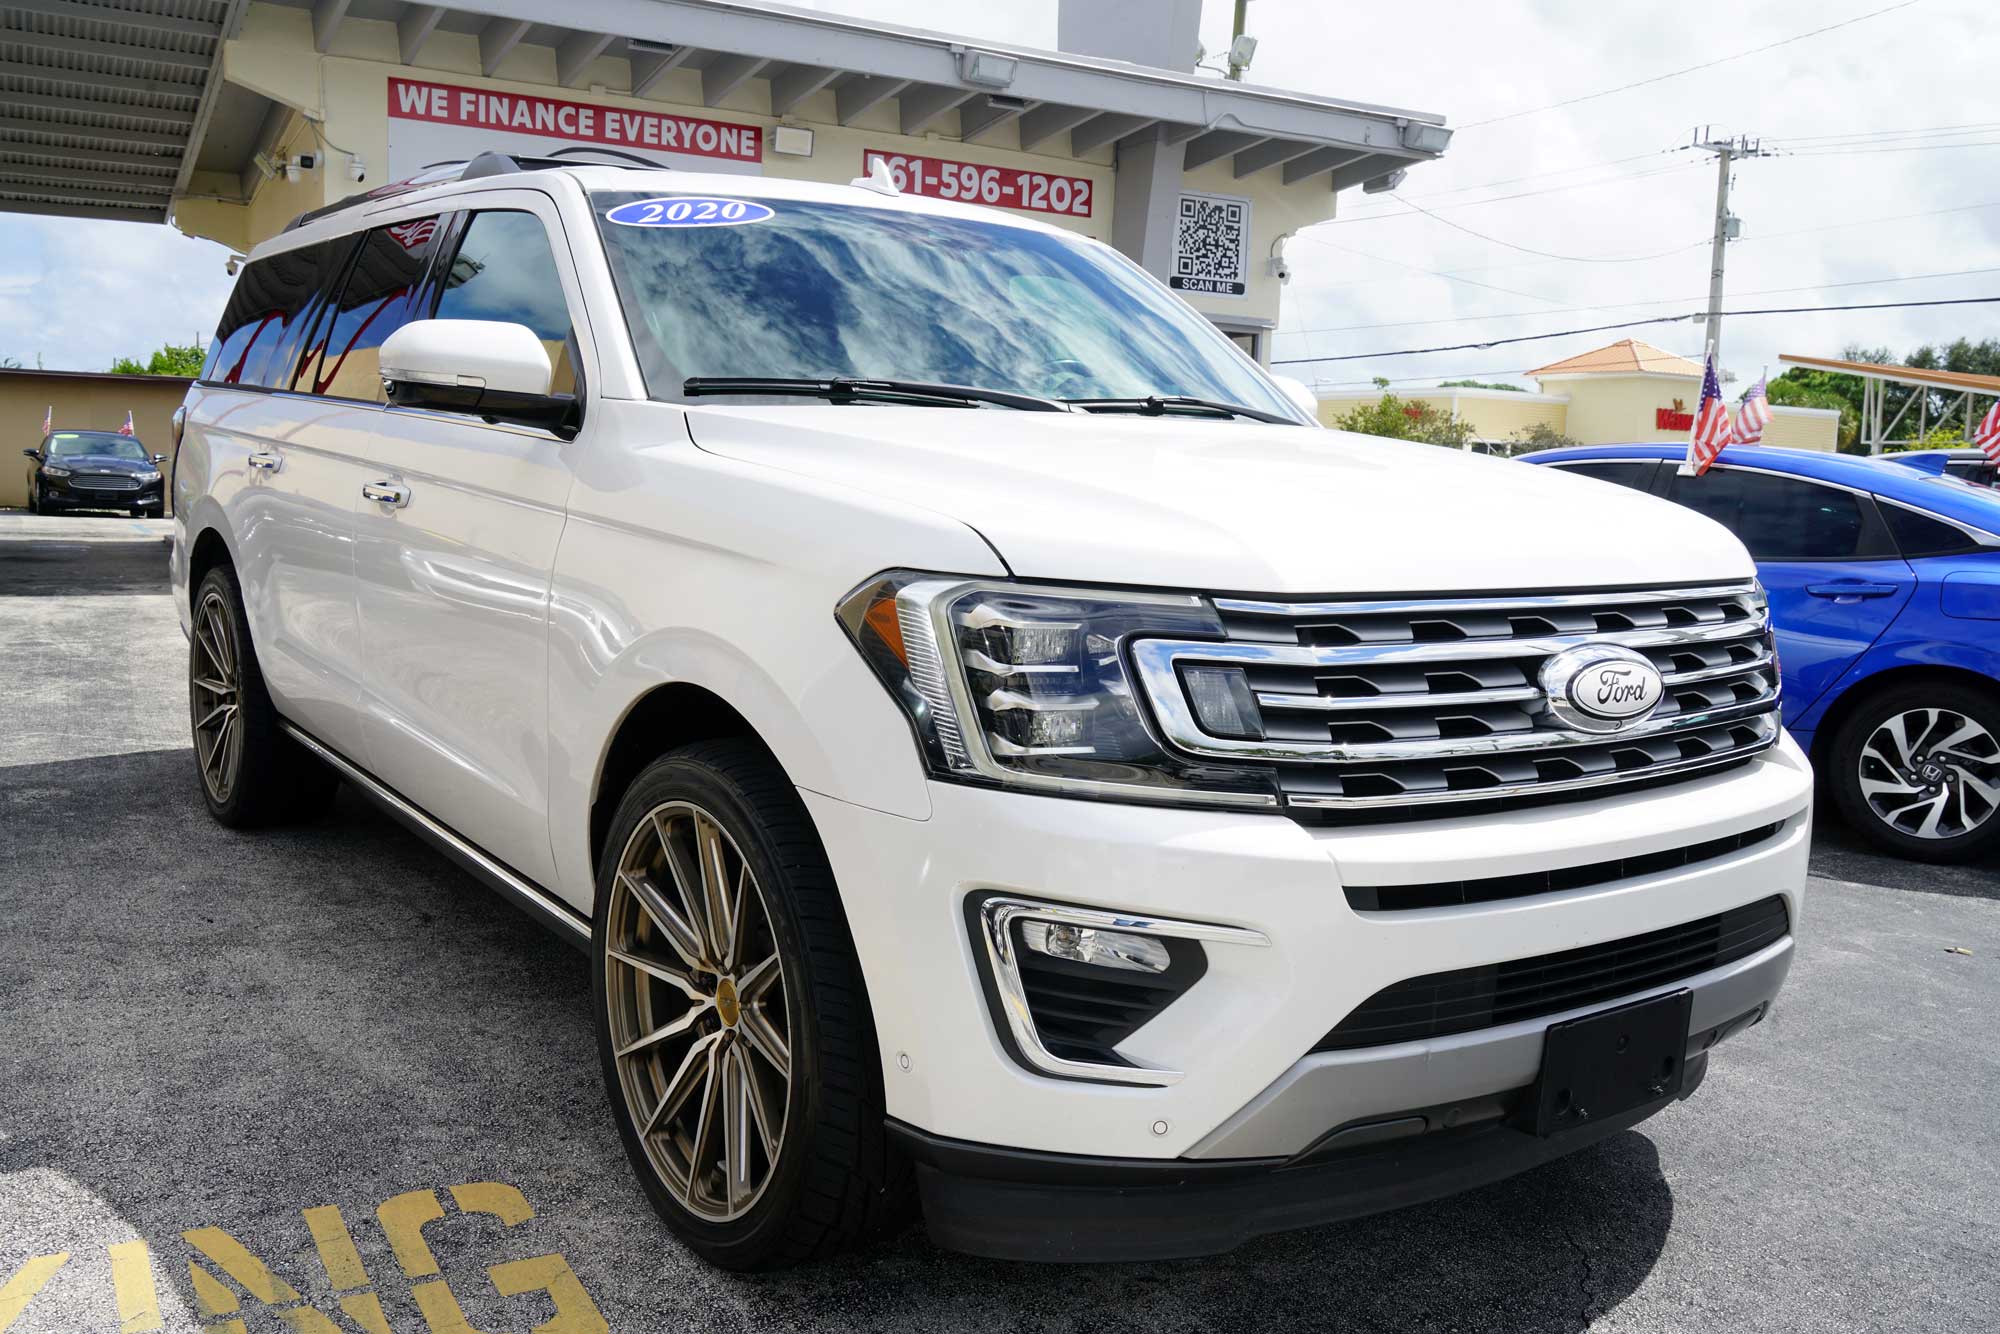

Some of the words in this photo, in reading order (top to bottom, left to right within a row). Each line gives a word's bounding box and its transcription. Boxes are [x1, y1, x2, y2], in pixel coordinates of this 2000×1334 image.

[397, 83, 449, 116] WE
[460, 91, 596, 136] FINANCE
[605, 112, 756, 157] EVERYONE
[637, 202, 747, 223] 2020
[1182, 278, 1213, 291] SCAN
[1216, 281, 1233, 293] ME
[1597, 670, 1648, 704] Ford
[0, 1182, 608, 1334] ING
